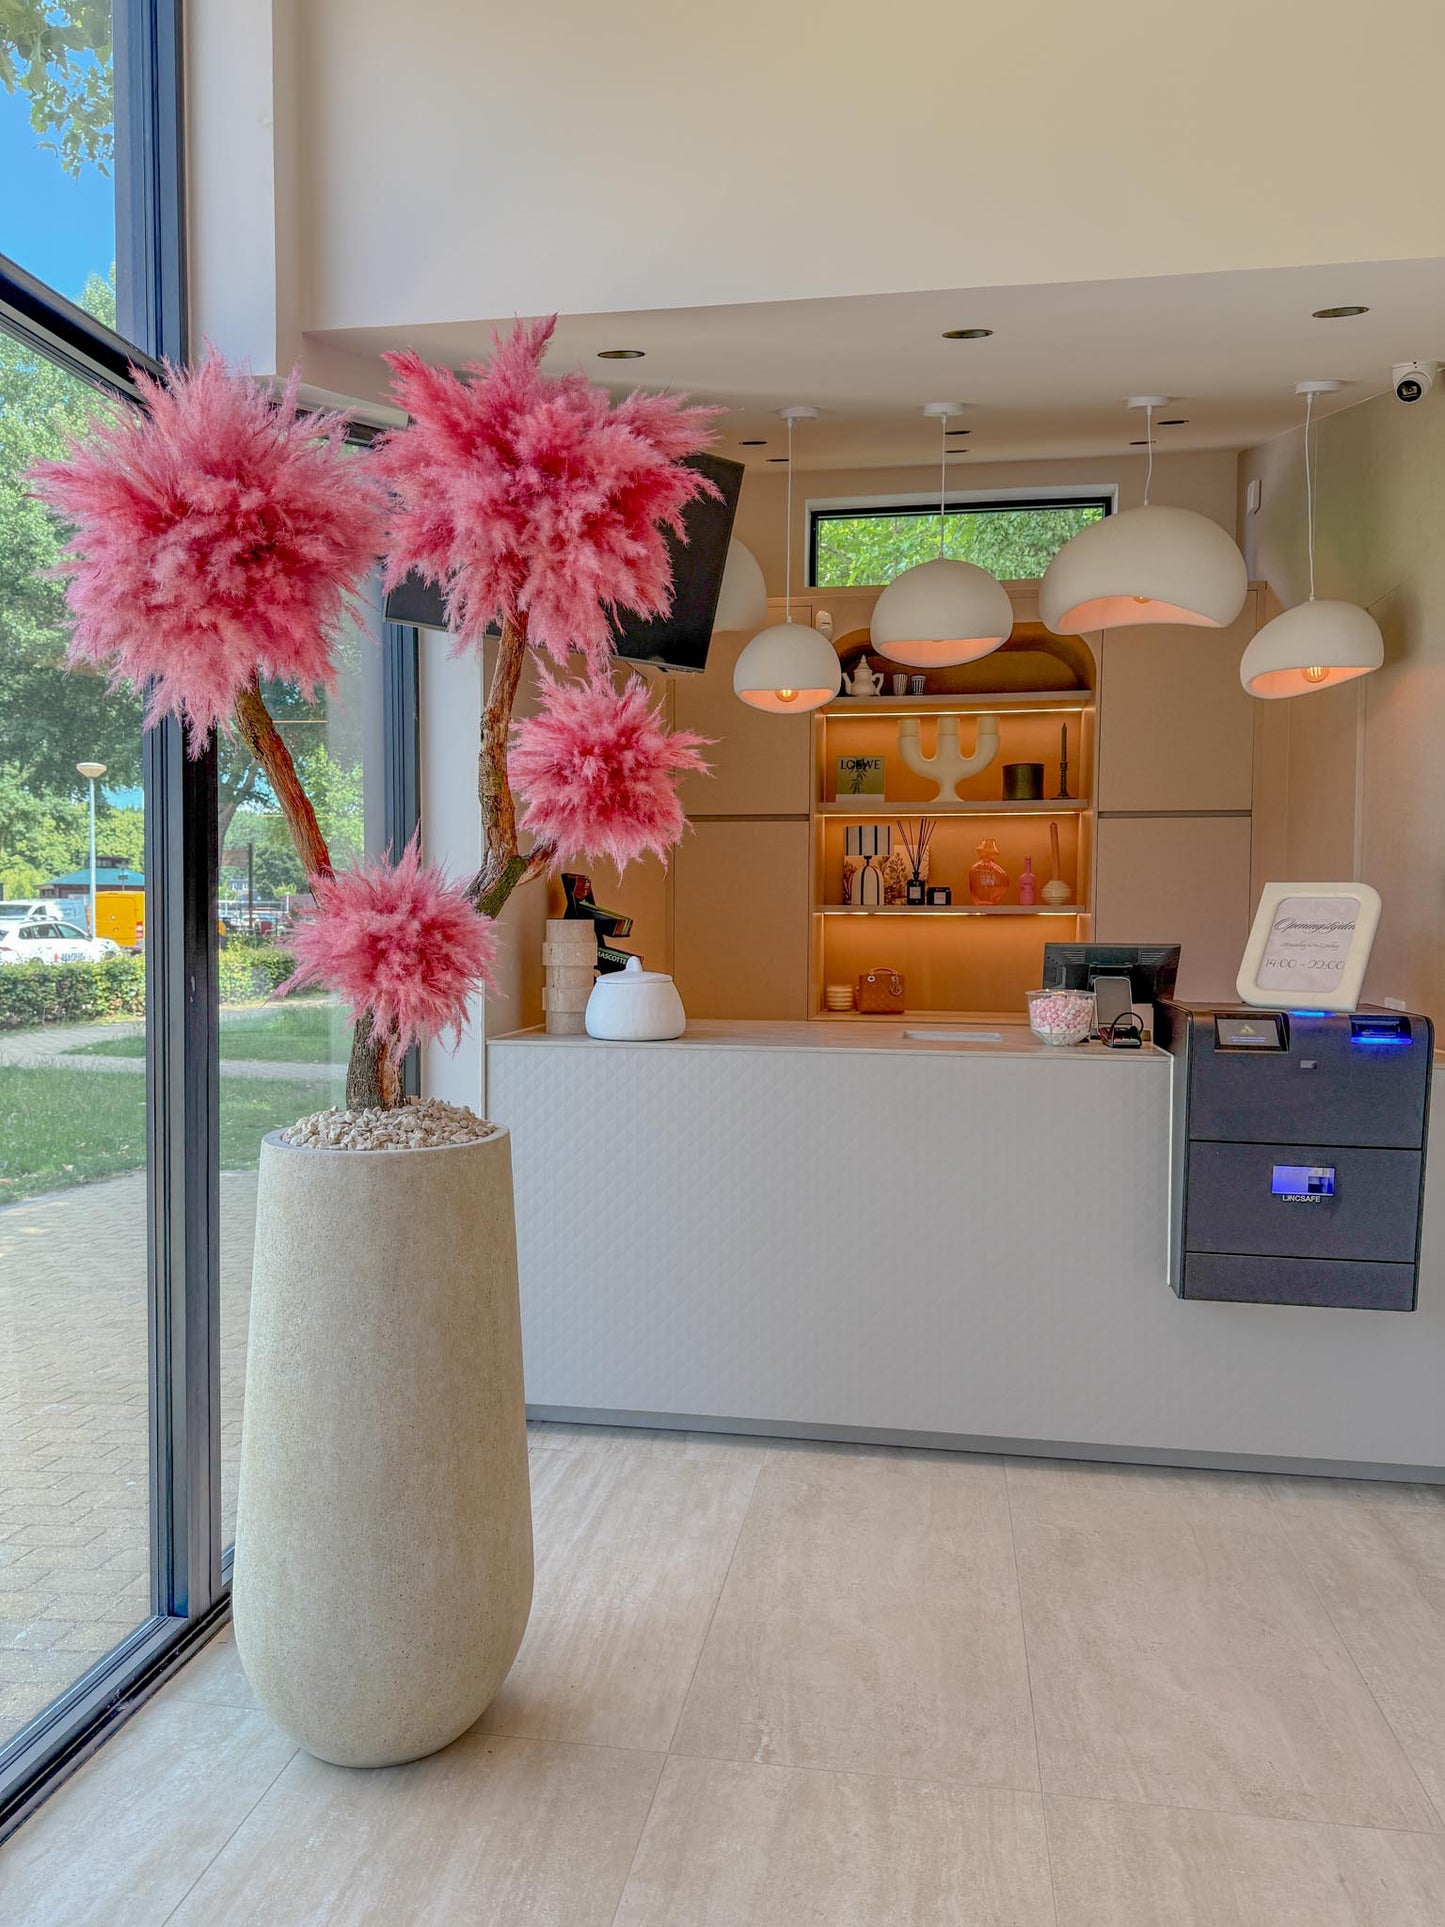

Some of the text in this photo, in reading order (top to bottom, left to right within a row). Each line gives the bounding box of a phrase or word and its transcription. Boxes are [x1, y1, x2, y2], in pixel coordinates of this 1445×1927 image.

[840, 759, 881, 770] LOEWE
[1265, 958, 1297, 969] 14:00
[1282, 1194, 1321, 1203] LINCSAFE
